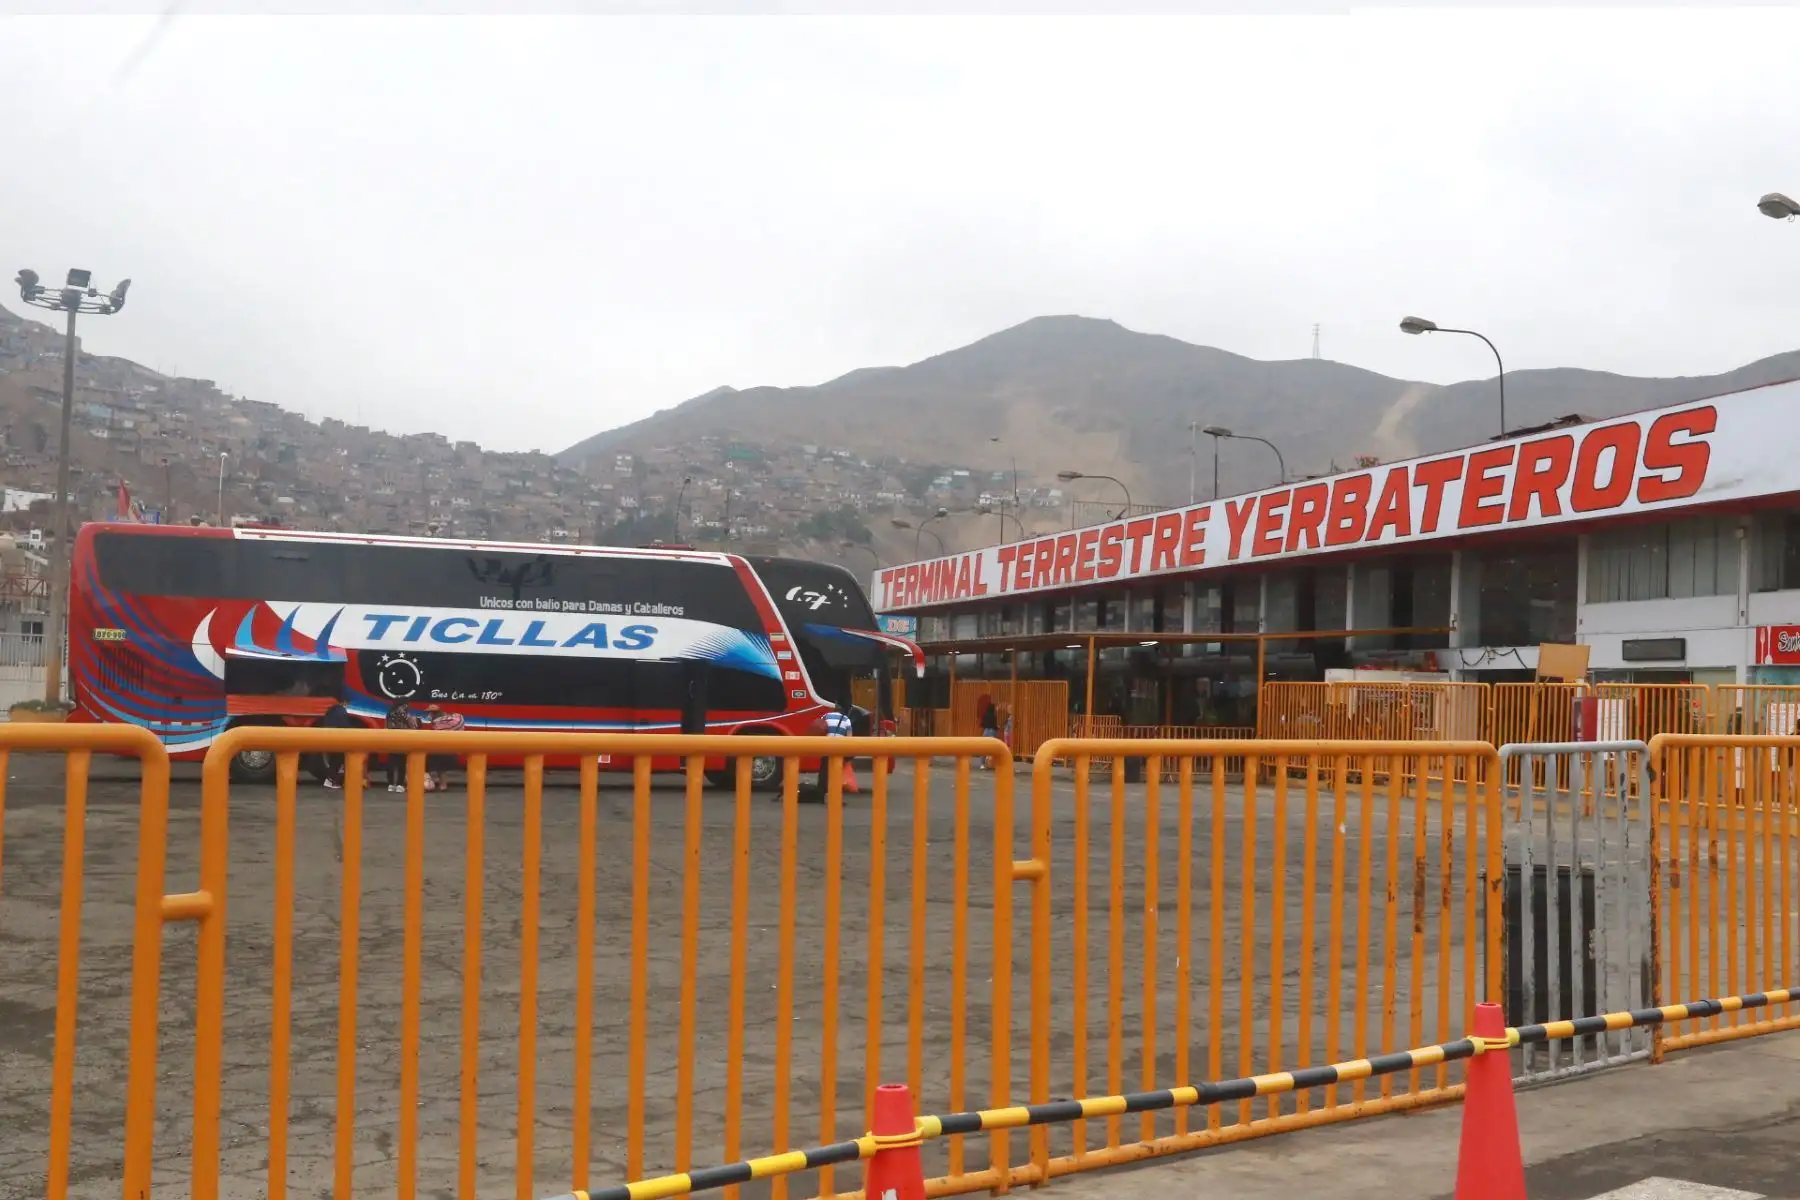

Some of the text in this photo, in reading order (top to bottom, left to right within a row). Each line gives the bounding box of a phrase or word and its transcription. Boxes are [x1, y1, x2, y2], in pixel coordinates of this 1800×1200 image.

[880, 404, 1718, 609] TERMINAL TERRESTRE YERBATEROS
[515, 599, 533, 609] con
[562, 600, 586, 612] para
[588, 600, 623, 612] Damas
[624, 603, 632, 615] y
[633, 602, 684, 616] Caballeros
[363, 613, 659, 651] TICLLAS
